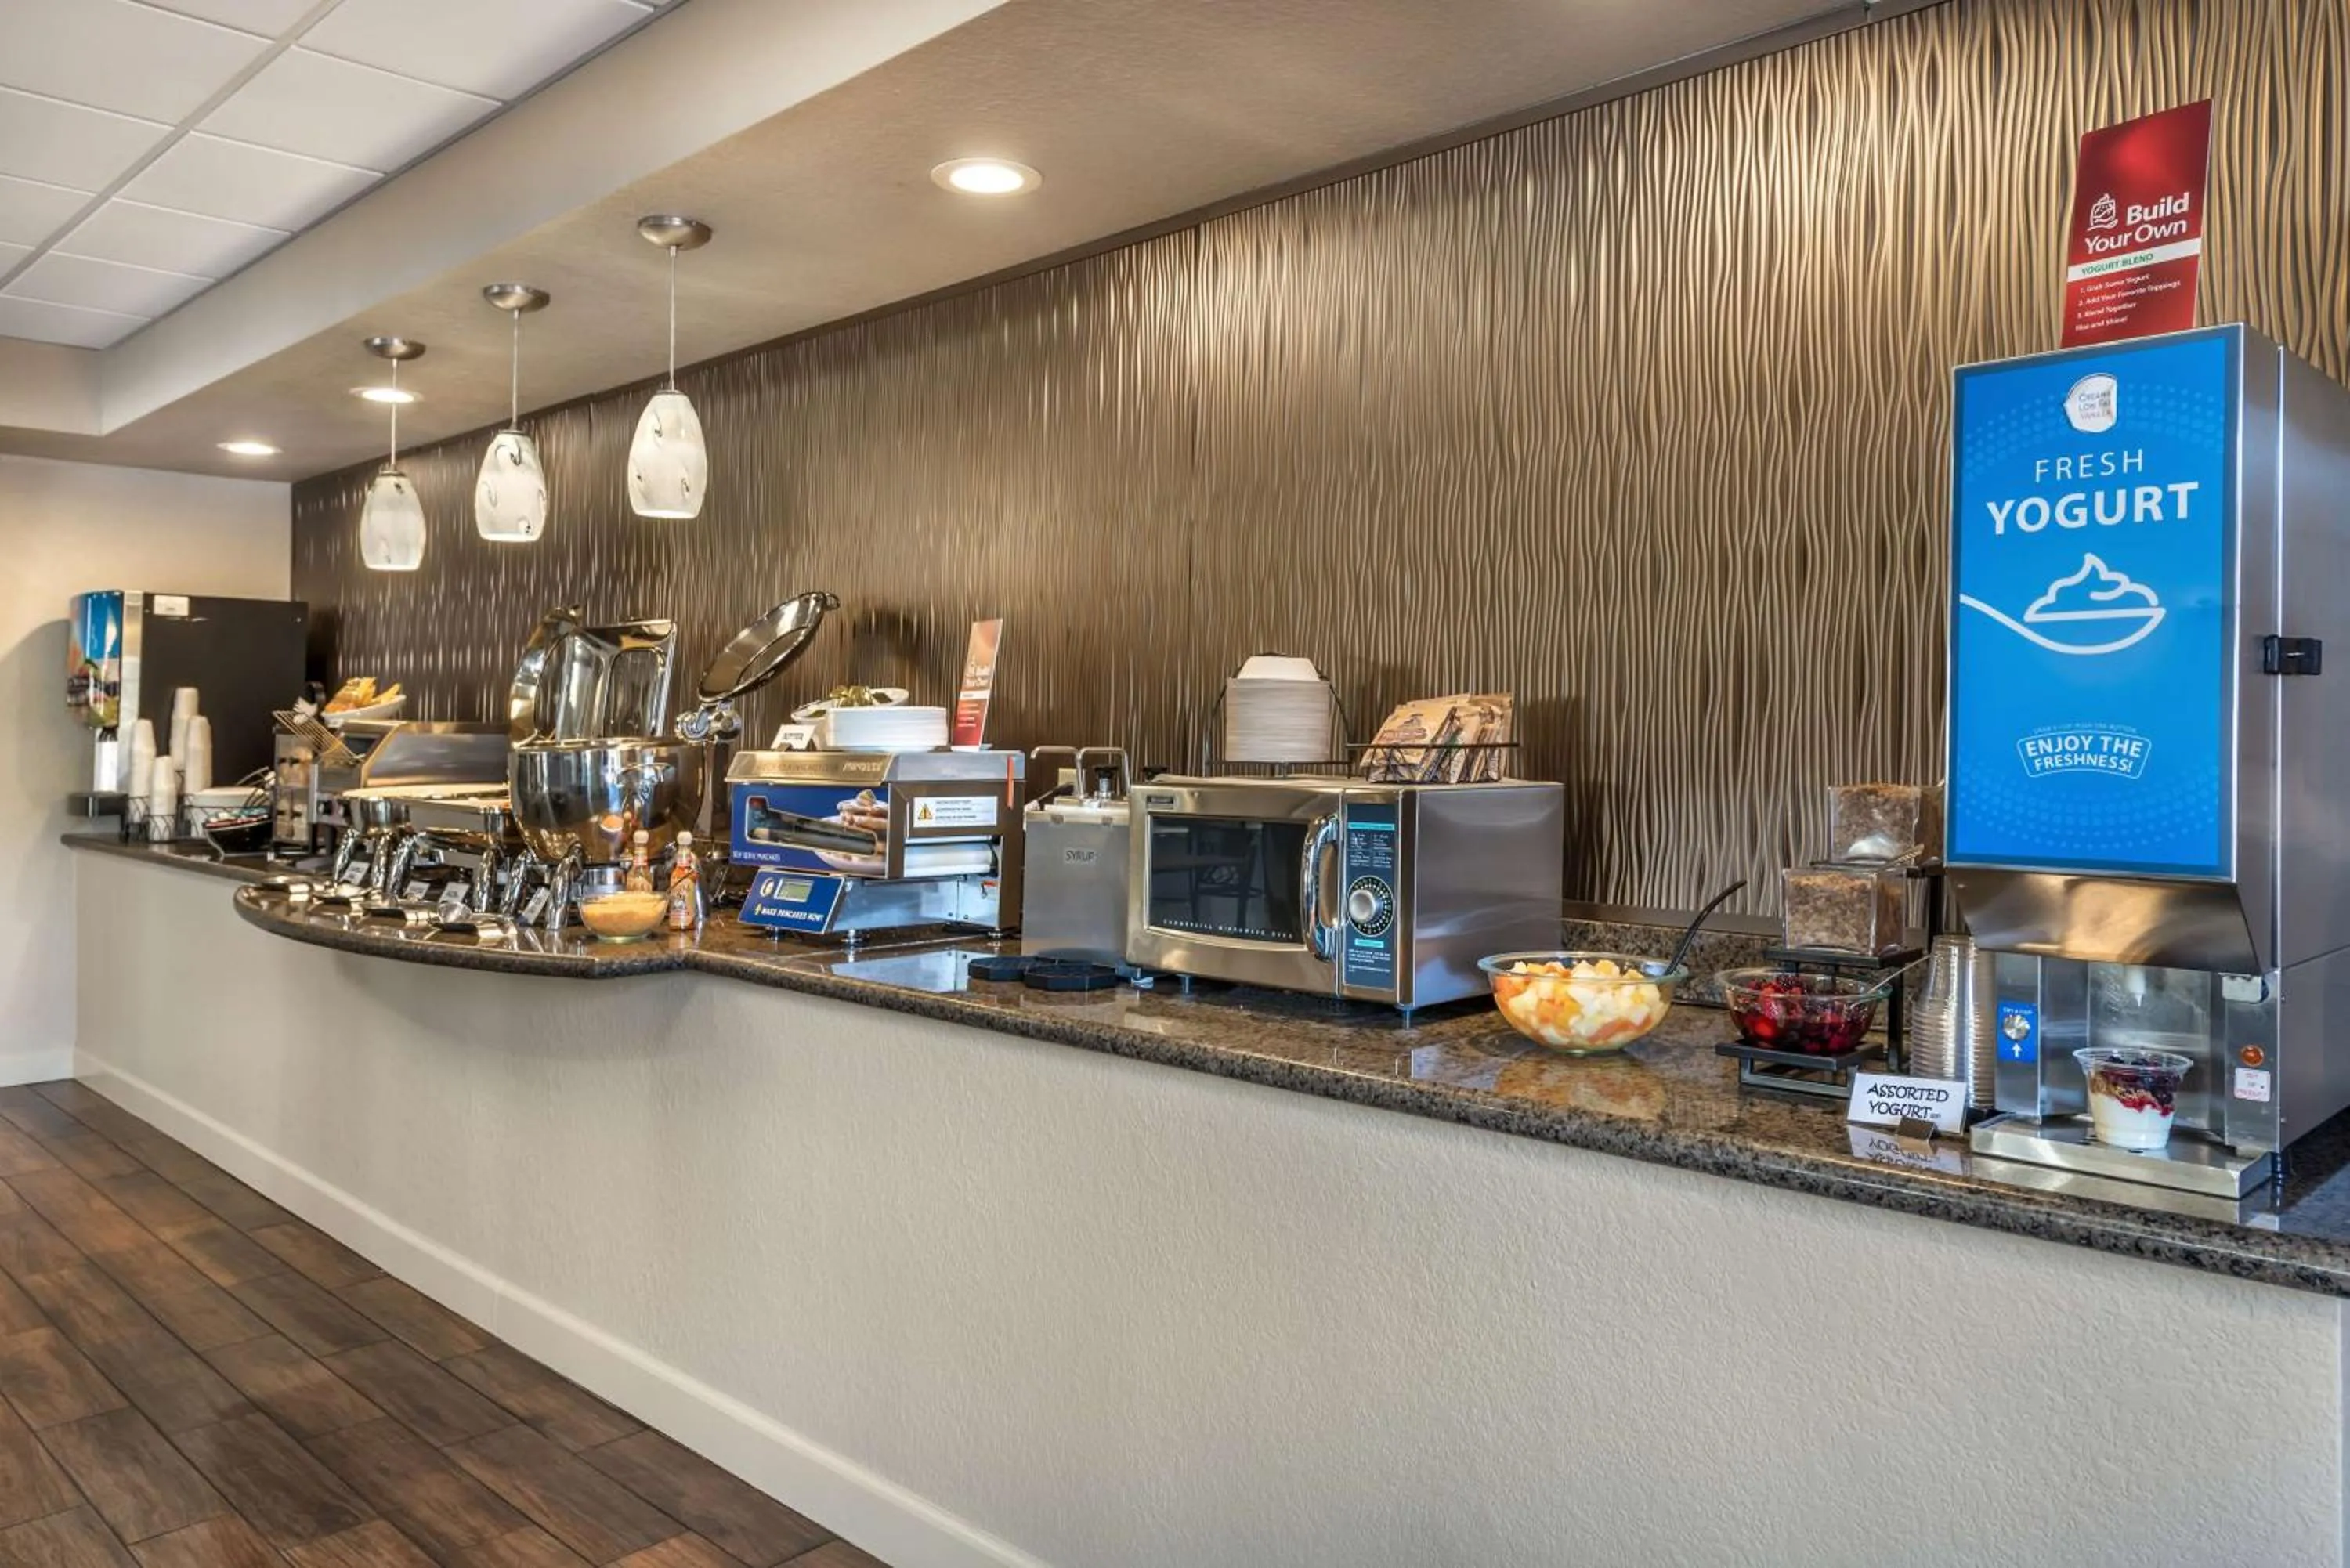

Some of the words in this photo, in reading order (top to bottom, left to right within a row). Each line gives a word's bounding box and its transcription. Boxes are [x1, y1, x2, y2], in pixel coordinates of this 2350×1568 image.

[2126, 191, 2190, 226] Build
[2084, 232, 2132, 255] Your
[2135, 219, 2187, 244] Own
[2081, 260, 2119, 275] YOGURT
[2121, 253, 2153, 266] BLEND
[2034, 448, 2143, 483] FRESH
[1986, 481, 2200, 536] YOGURT
[2025, 735, 2094, 758] ENJOY
[2099, 735, 2144, 758] THE
[2034, 753, 2135, 773] FRESHNESS!
[1065, 850, 1095, 862] SYRUP
[1162, 918, 1213, 930] COMMERCIAL
[1218, 925, 1266, 937] MICROWAVE
[1271, 930, 1293, 940] OVEN
[1867, 1082, 1950, 1103] ASSORTED
[1868, 1100, 1933, 1120] YOGURT
